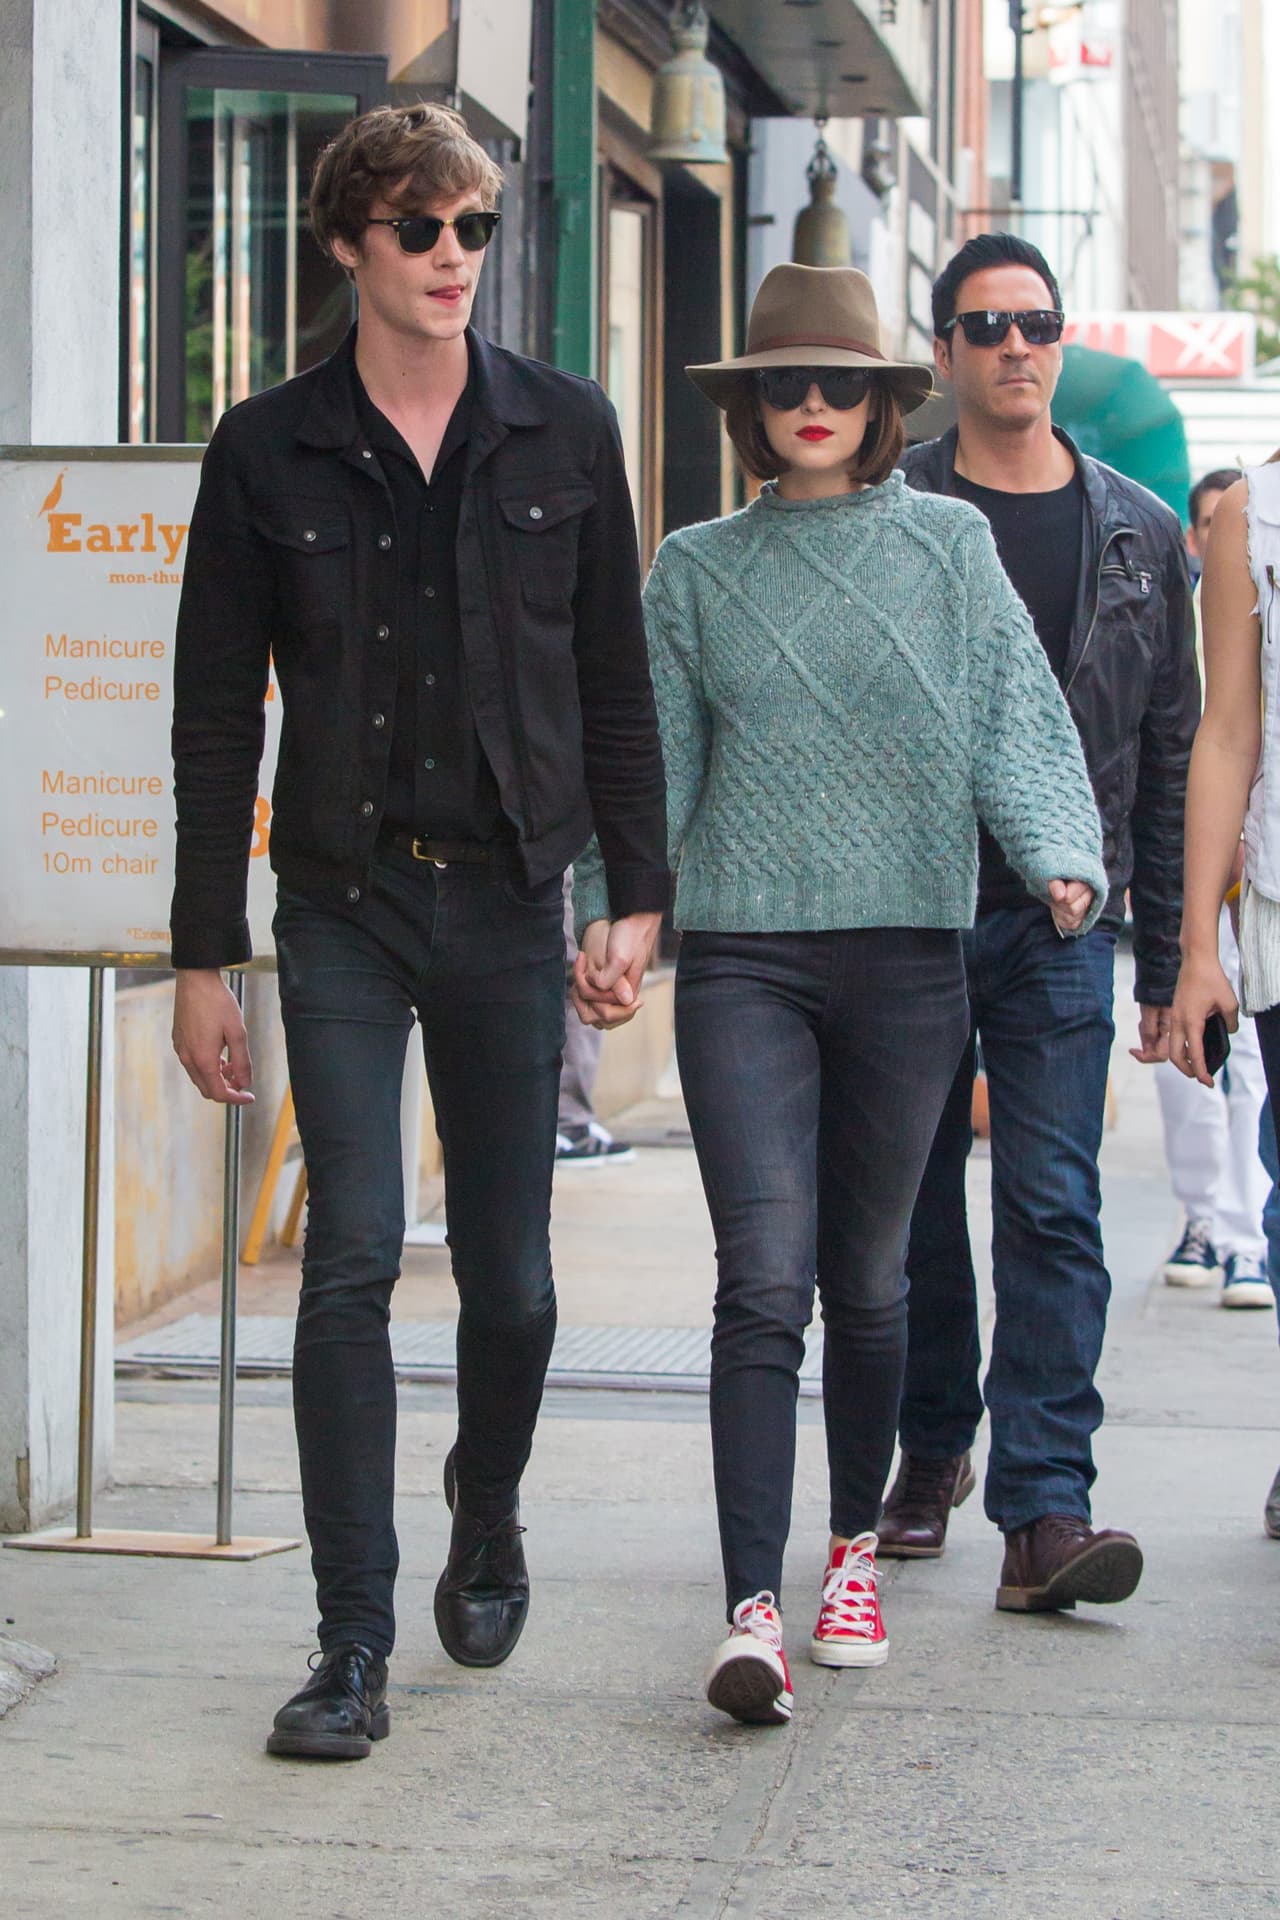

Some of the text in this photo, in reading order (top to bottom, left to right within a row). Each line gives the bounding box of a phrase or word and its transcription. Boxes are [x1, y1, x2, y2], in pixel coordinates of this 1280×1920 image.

[47, 512, 189, 565] Early
[45, 634, 165, 659] Manicure
[44, 675, 160, 701] Pedicure
[42, 770, 163, 795] Manicure
[41, 812, 158, 838] Pedicure
[43, 851, 160, 875] 10m chair
